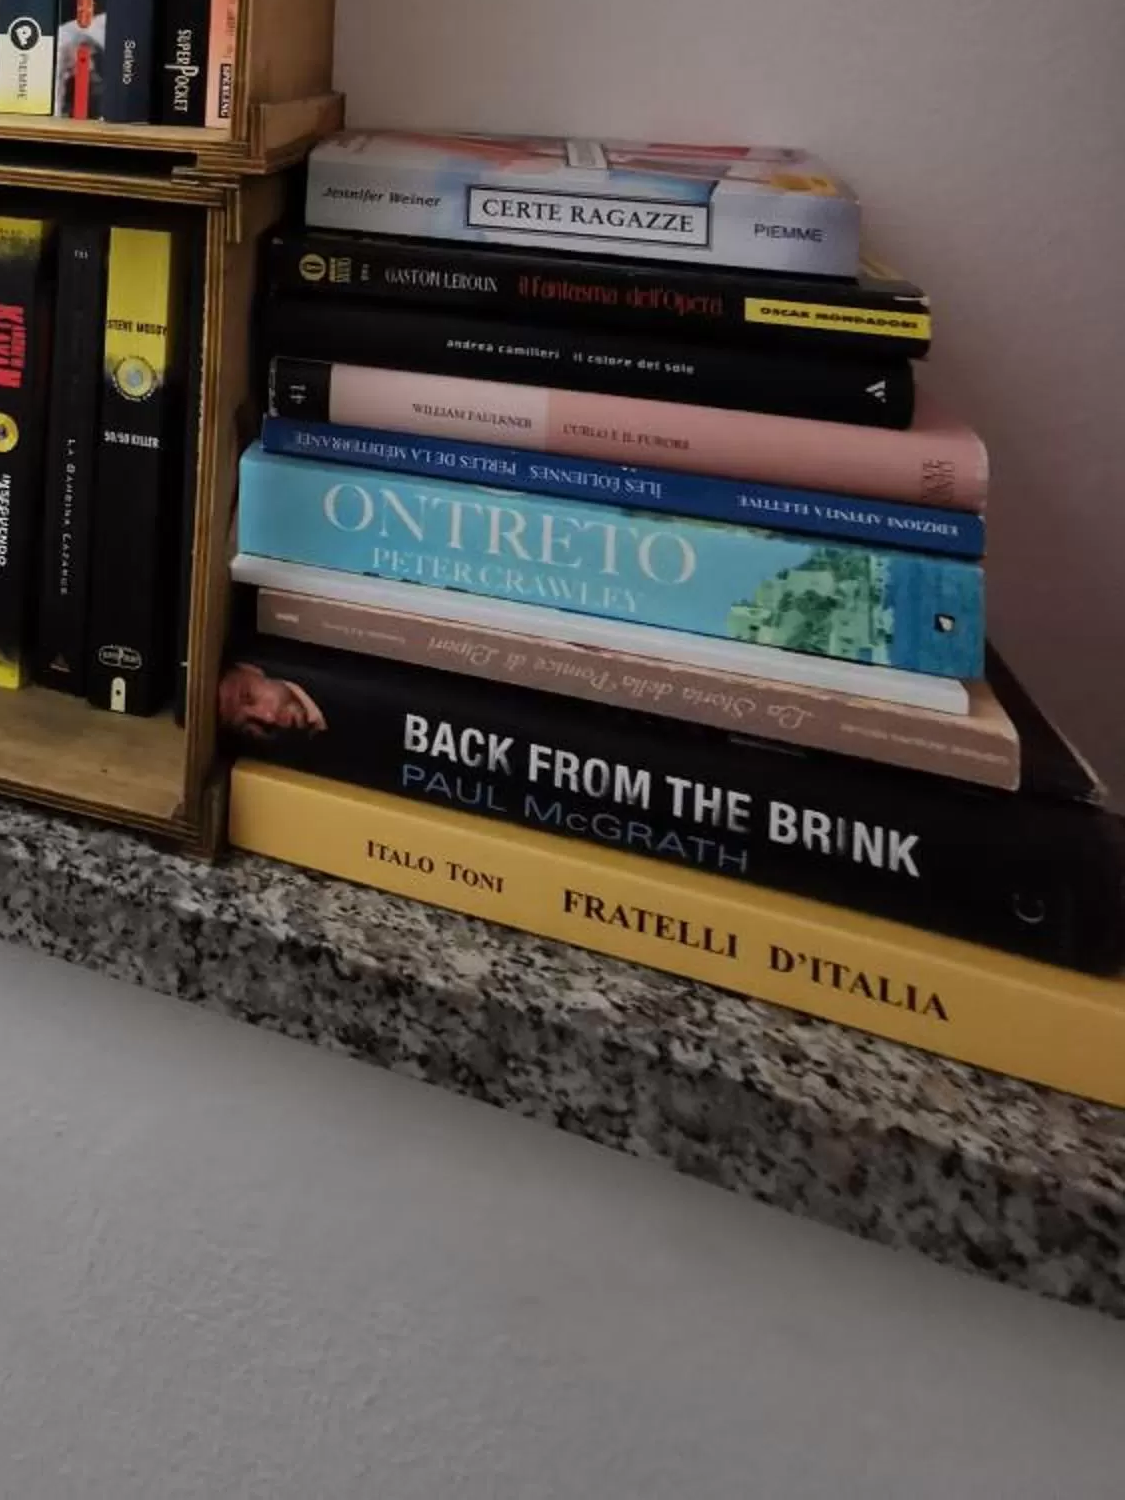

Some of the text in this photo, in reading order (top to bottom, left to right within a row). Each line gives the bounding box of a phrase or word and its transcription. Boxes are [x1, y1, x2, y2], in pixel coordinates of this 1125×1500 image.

[121, 40, 136, 85] Sellerio
[322, 185, 442, 208] Jennifer Weiner
[481, 198, 695, 234] CERTE RAGAZZE
[753, 222, 824, 244] PIEMME
[384, 269, 442, 289] GASTON
[444, 274, 499, 293] LEROUX
[760, 305, 811, 320] OSCAR
[446, 338, 494, 353] andrea
[498, 343, 560, 360] camilleri
[586, 353, 633, 368] colore
[637, 356, 661, 372] del
[664, 359, 695, 375] sole
[411, 402, 532, 429] WILLIAM FAULKNER
[410, 447, 518, 477] PERLES DE LA
[737, 495, 960, 537] EDIZIONI ELETTIVE
[322, 483, 697, 584] ONTRETO
[371, 547, 638, 614] PETER CRAWLEY
[427, 634, 501, 667] Lipari
[504, 652, 527, 671] di
[621, 673, 675, 699] della
[683, 687, 757, 719] Storia
[402, 712, 922, 879] BACK FROM THE BRINK
[400, 762, 750, 875] PAUL McGRATH
[366, 838, 505, 895] ITALO TONI
[562, 887, 950, 1023] FRATELLI D'ITALIA
